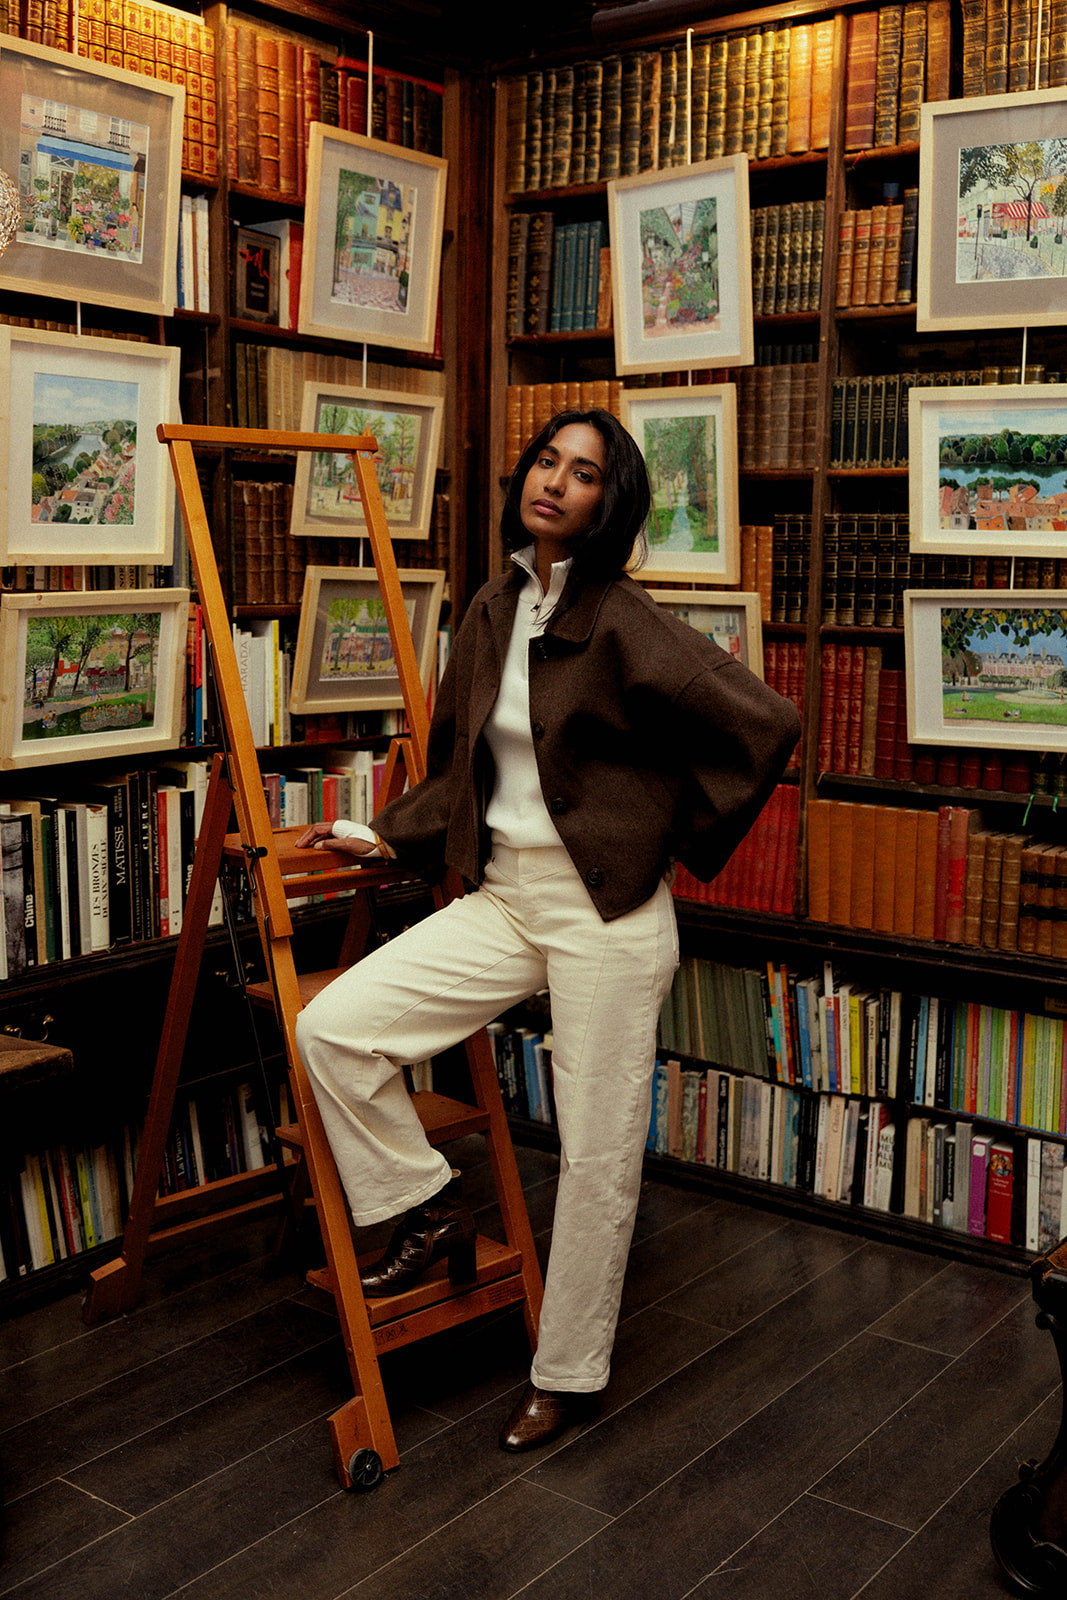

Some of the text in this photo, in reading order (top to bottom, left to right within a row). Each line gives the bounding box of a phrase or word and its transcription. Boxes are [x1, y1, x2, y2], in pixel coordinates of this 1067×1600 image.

[240, 641, 248, 691] HARADA
[91, 843, 101, 917] LES BRONZES
[114, 825, 126, 886] MATISSE
[24, 894, 34, 928] Chine
